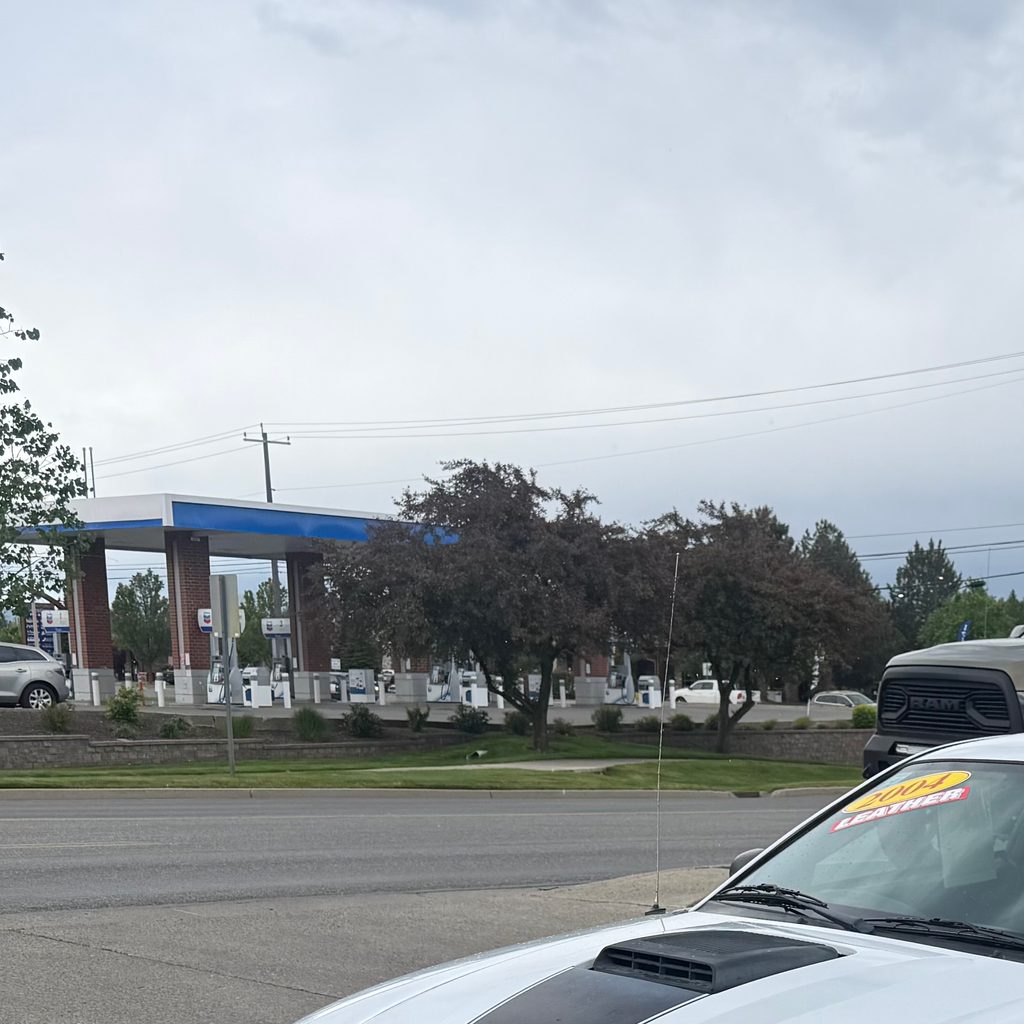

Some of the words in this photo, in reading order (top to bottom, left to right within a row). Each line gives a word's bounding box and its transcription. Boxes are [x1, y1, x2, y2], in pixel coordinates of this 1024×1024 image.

[910, 696, 959, 712] RAM
[834, 787, 965, 832] LEATHER
[855, 773, 950, 810] 2004
